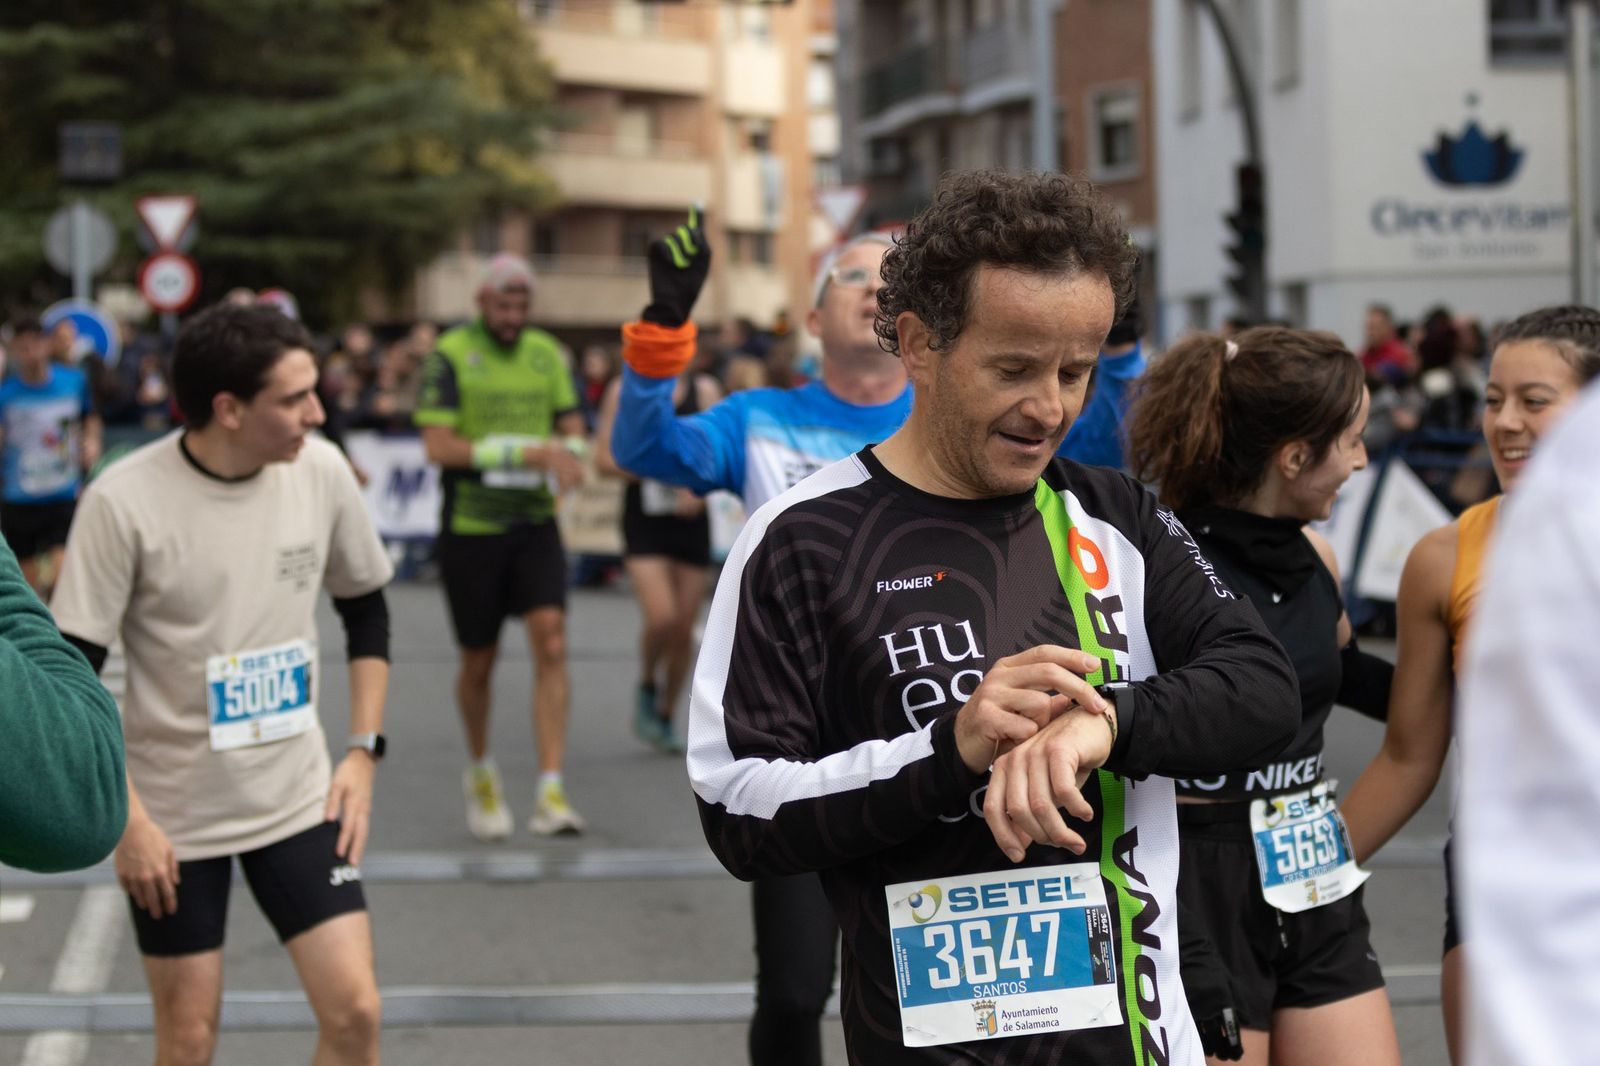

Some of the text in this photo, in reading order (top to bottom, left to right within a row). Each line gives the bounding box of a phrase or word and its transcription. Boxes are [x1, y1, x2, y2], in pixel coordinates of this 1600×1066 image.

[876, 576, 933, 593] FLOWER
[879, 619, 985, 677] Hu
[223, 669, 298, 718] 5004
[1245, 757, 1317, 791] NIKE
[948, 876, 1087, 913] SETEL
[1100, 913, 1109, 934] 3647
[923, 912, 1060, 989] 3647
[973, 981, 1028, 998] SANTOS
[1001, 1005, 1059, 1020] Ayuntamiento
[1003, 1018, 1060, 1032] de Salamanca
